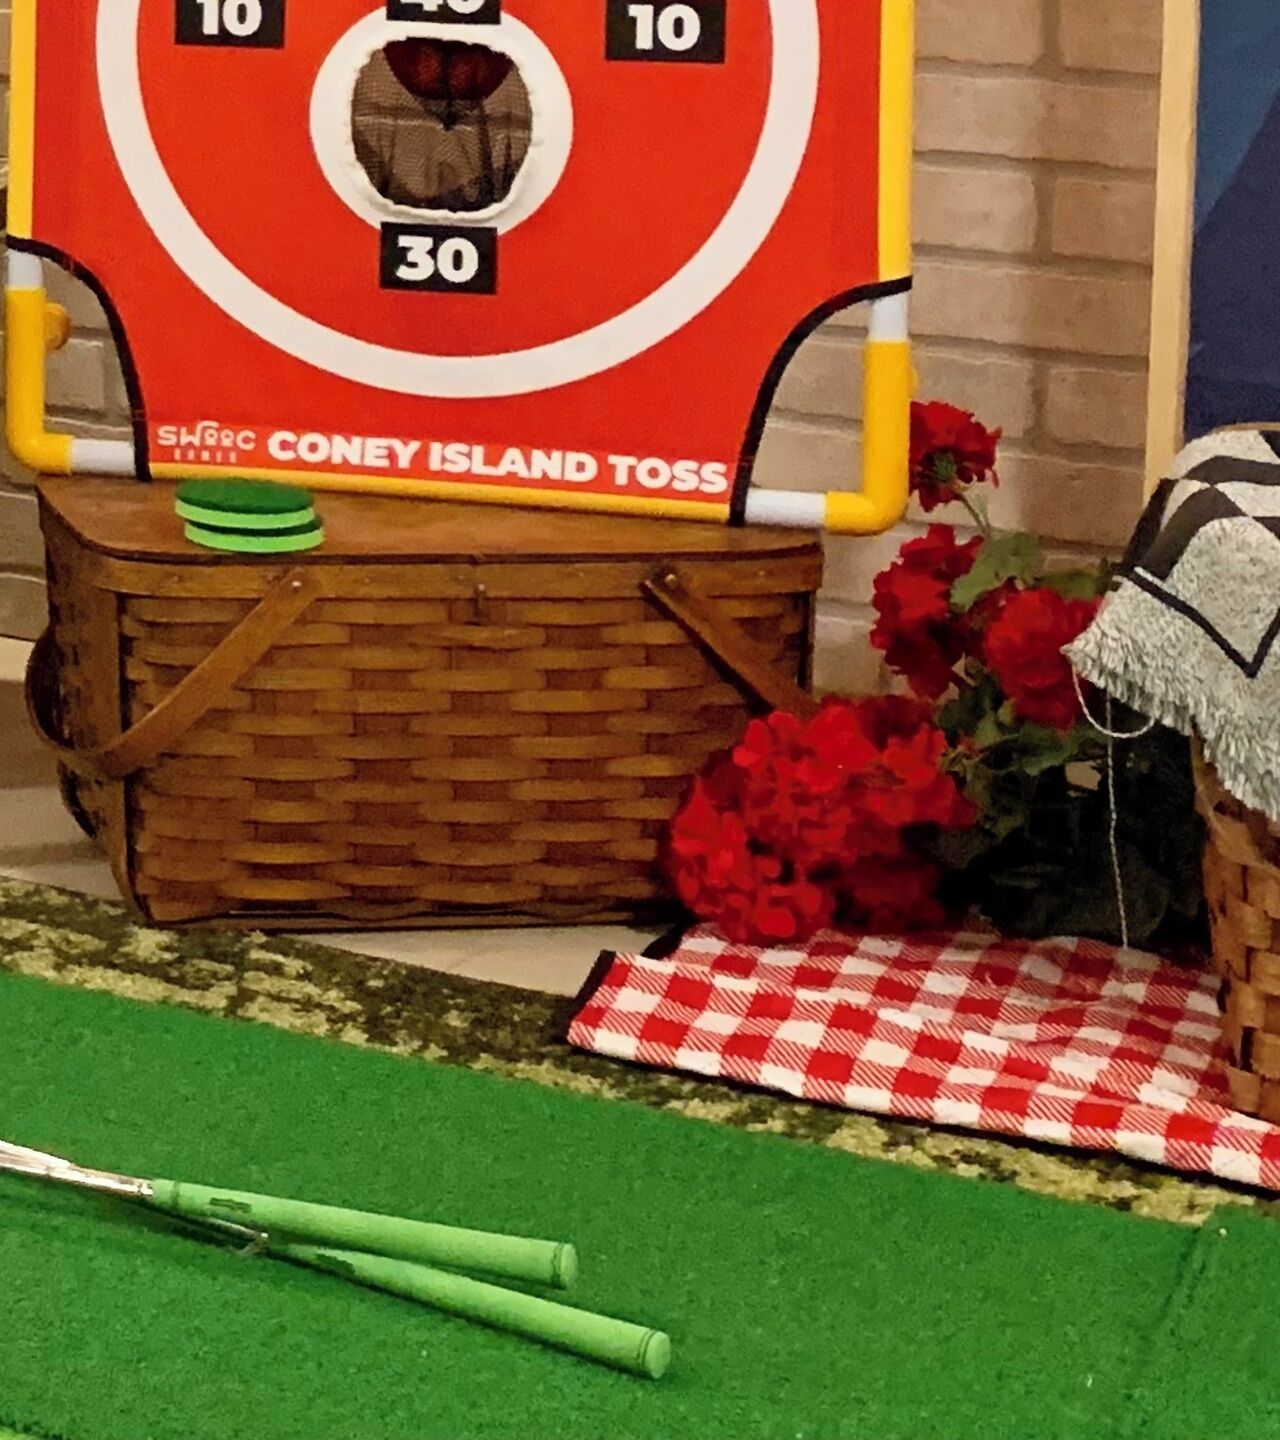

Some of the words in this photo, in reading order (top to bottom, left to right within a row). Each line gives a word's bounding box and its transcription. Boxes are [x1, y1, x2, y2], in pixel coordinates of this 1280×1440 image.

[629, 3, 701, 52] 10
[395, 235, 479, 284] 30
[267, 430, 421, 469] CONEY
[429, 441, 598, 482] ISLAND
[607, 454, 729, 493] TOSS
